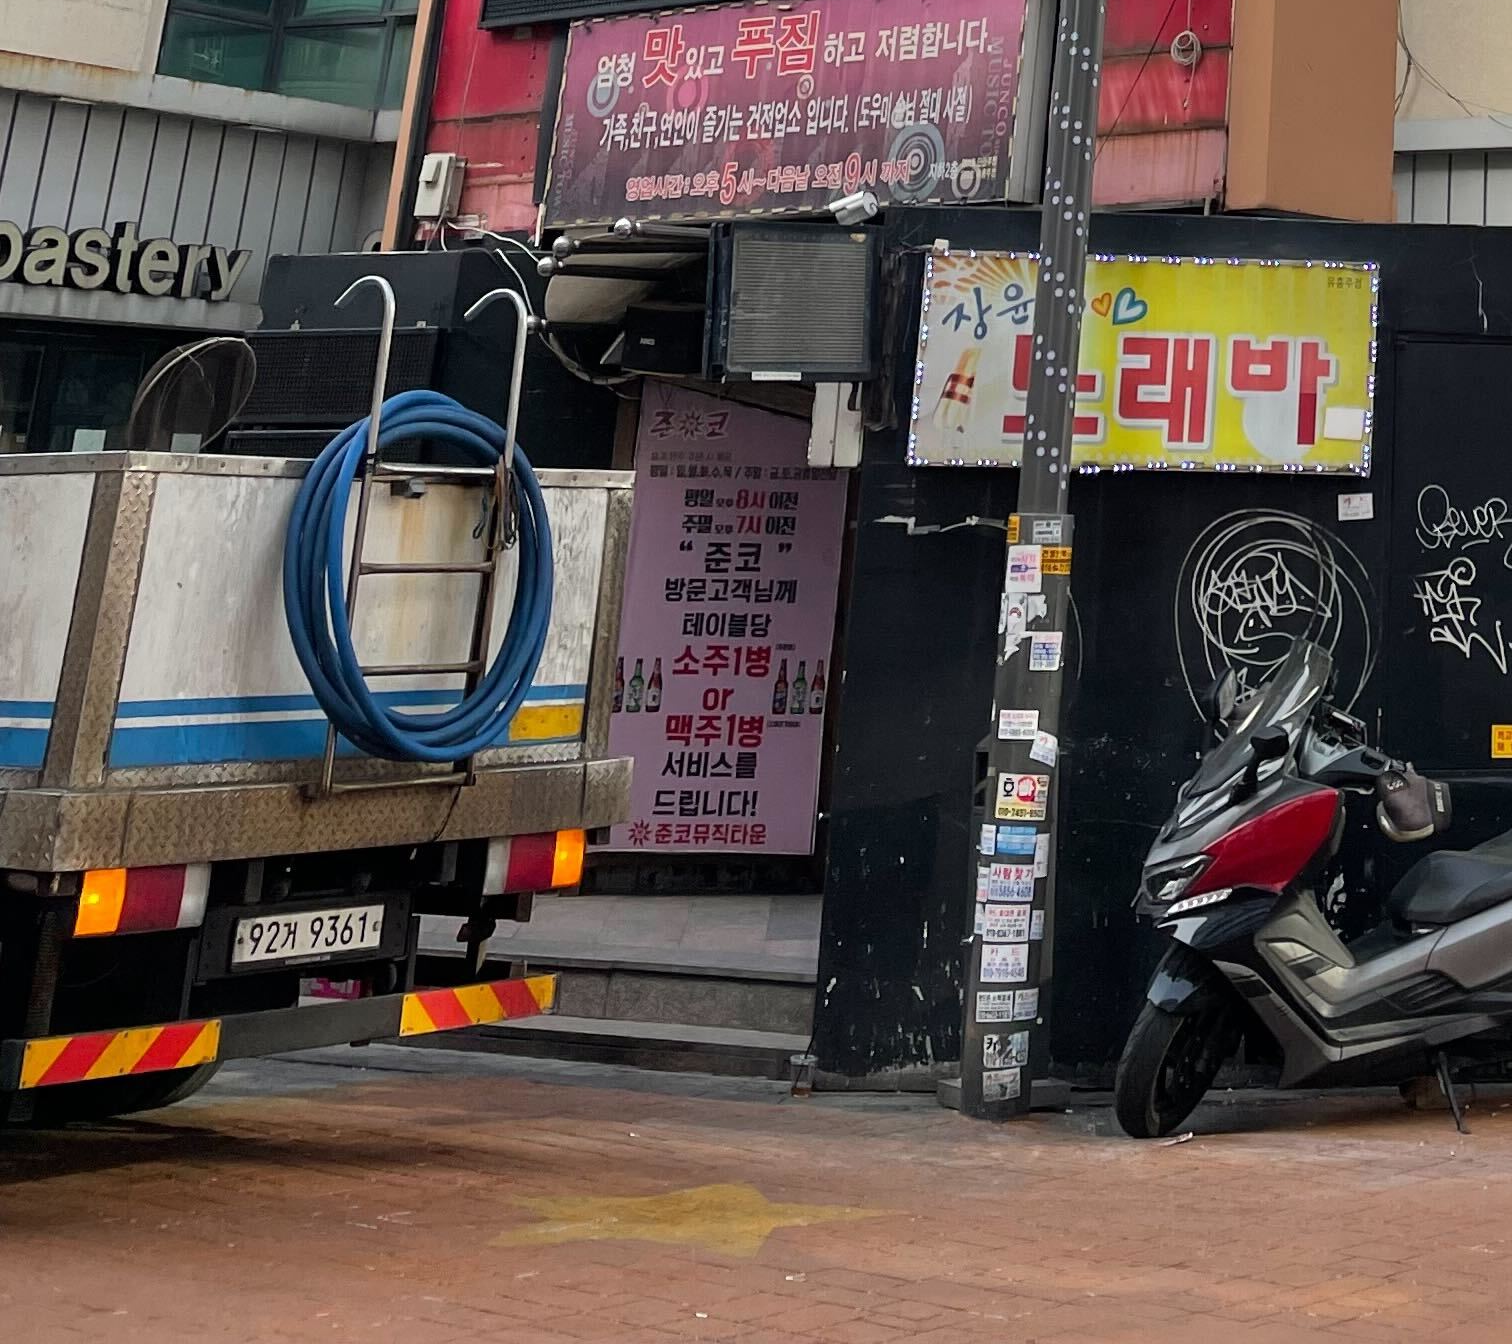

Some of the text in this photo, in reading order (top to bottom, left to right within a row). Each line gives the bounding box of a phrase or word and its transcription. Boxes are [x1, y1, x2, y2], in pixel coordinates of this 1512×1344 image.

[597, 51, 637, 89] 엄청
[702, 103, 744, 144] 즐기는
[735, 488, 766, 510] 8시
[768, 490, 799, 511] 이전
[735, 514, 762, 536] 7시
[764, 515, 797, 536] 이전
[664, 576, 798, 606] 방문고객님께
[682, 611, 773, 640] 테이블당
[671, 644, 773, 679] 소주1병
[702, 687, 735, 712] or
[664, 713, 765, 749] 맥주1병
[660, 751, 759, 781] 서비스를
[650, 789, 759, 818] 드립니다!
[653, 821, 768, 847] 준코뮤직타운
[249, 912, 368, 955] 92거 9361
